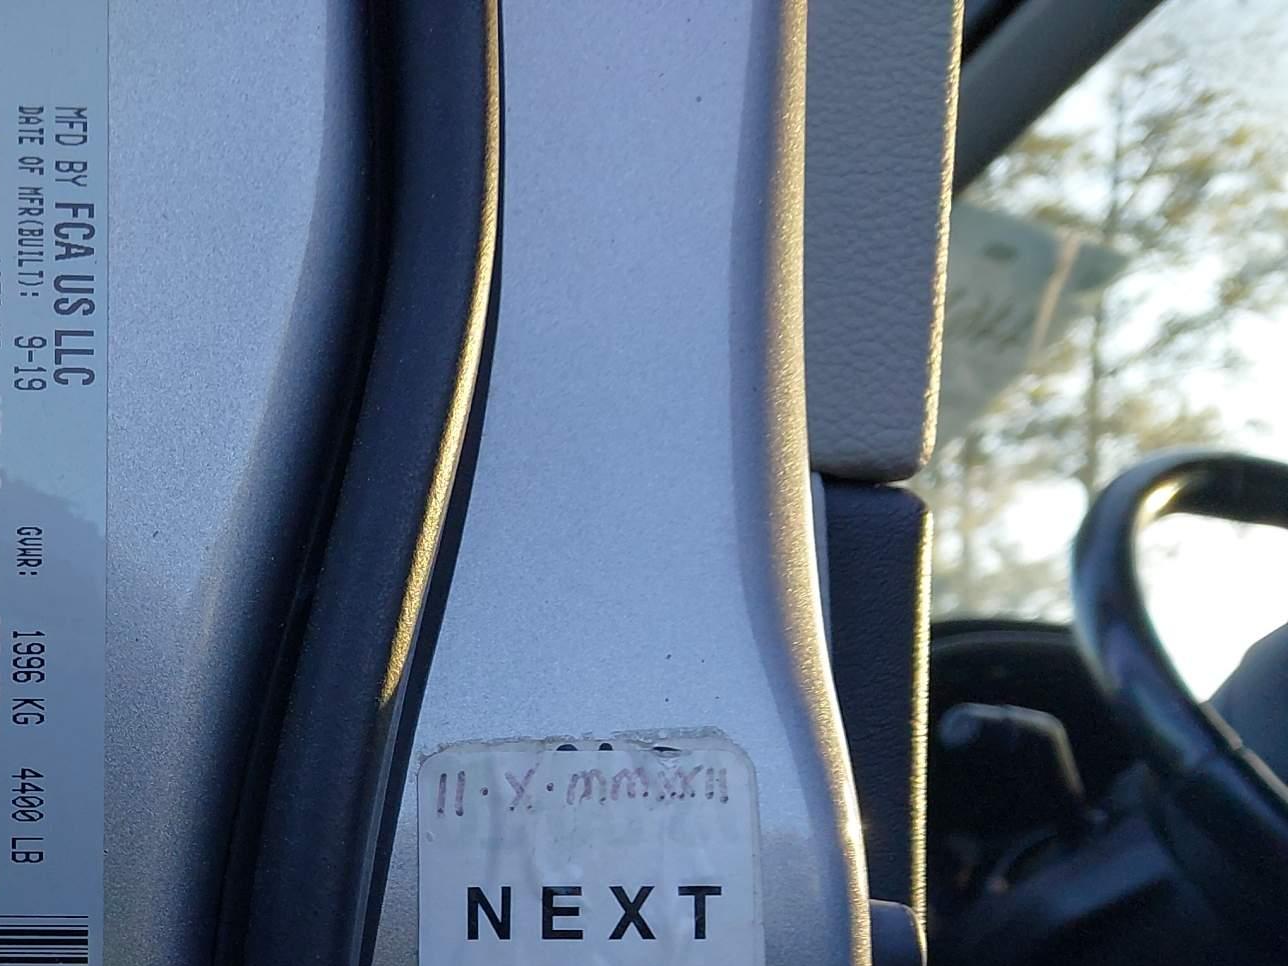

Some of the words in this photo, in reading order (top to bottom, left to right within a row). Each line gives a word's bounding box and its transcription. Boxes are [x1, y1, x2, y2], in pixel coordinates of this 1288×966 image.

[19, 106, 44, 145] DATE
[55, 107, 87, 146] MFD
[18, 157, 44, 175] OF
[55, 161, 87, 187] BY
[54, 203, 95, 261] FCA
[54, 275, 95, 316] US
[14, 336, 47, 390] 9-19
[53, 330, 95, 385] LLC
[17, 527, 42, 575] GVWR:
[13, 631, 45, 682] 1996
[12, 699, 44, 724] KG
[12, 768, 44, 821] 4400
[12, 838, 43, 863] LB
[467, 886, 722, 940] NEXT
